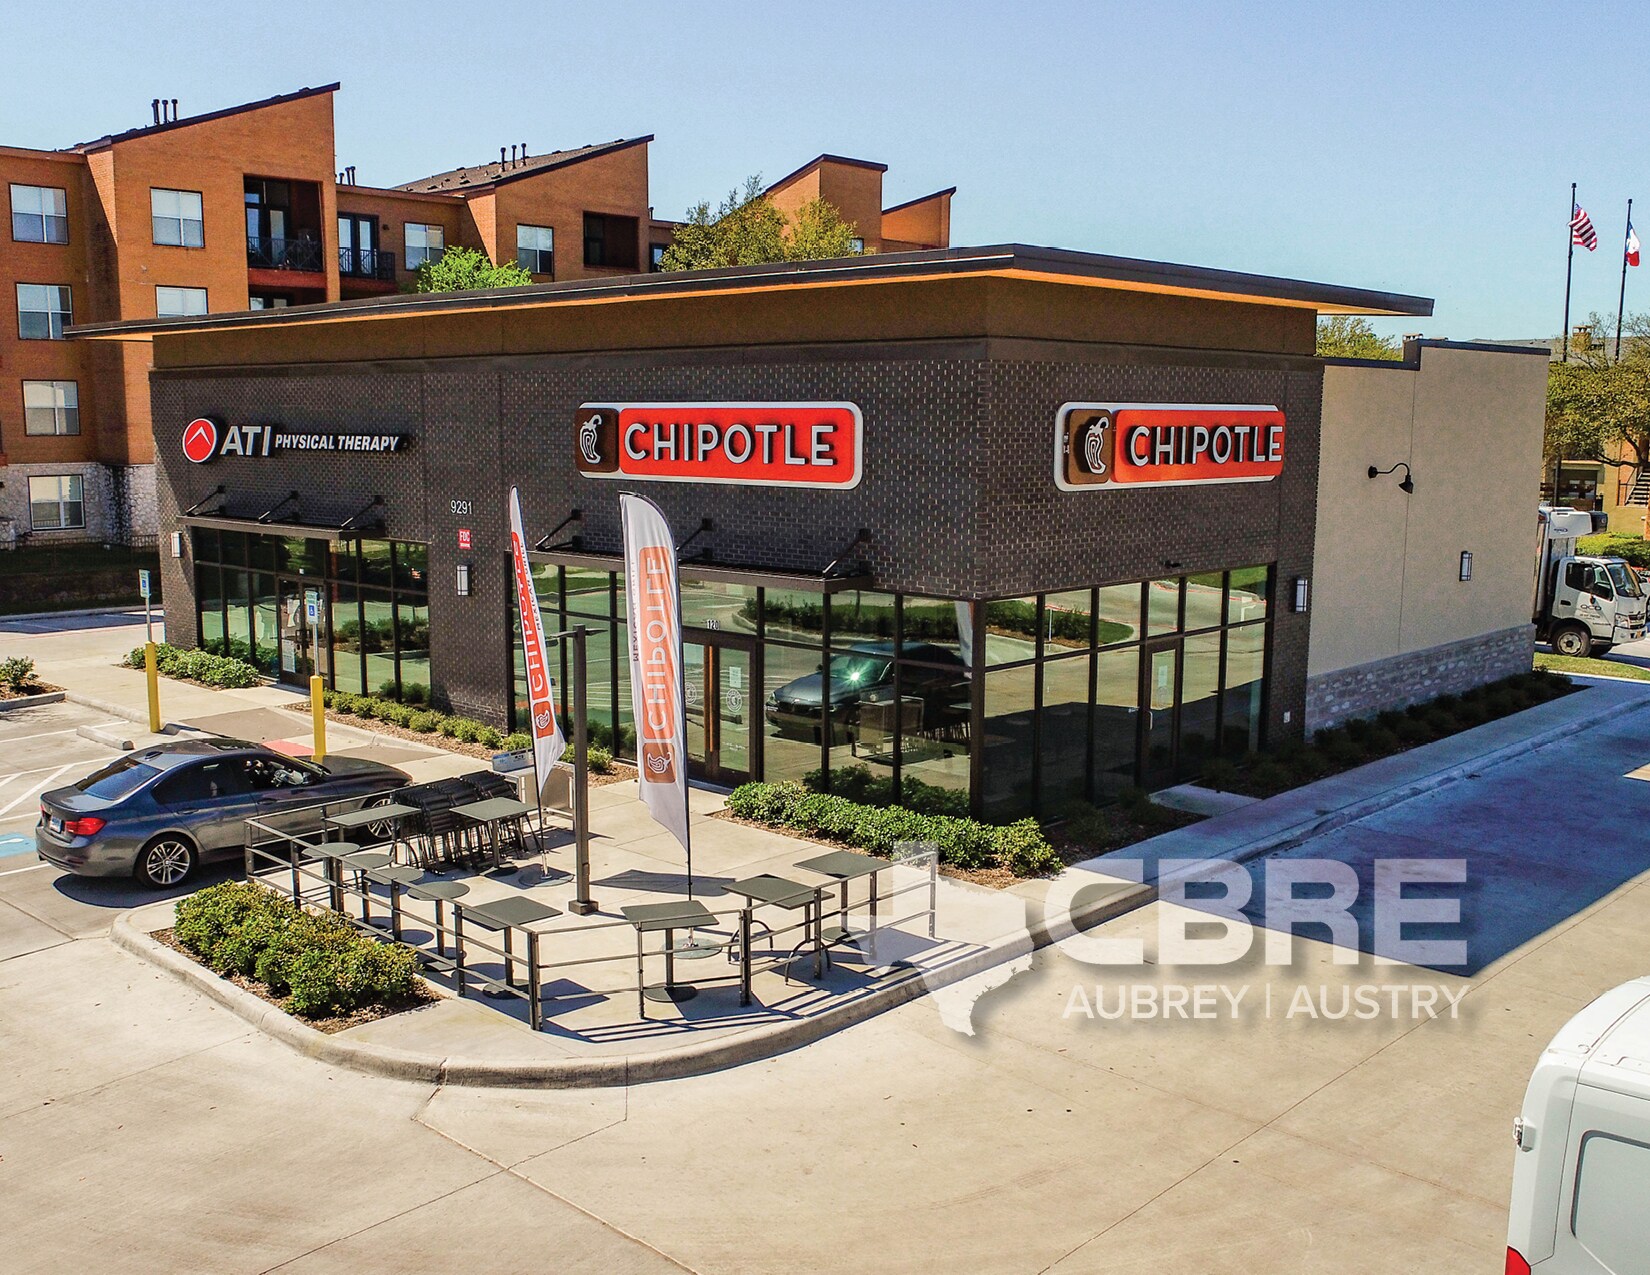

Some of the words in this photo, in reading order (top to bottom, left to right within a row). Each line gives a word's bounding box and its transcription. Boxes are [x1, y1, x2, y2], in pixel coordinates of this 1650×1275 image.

[220, 425, 272, 456] ATI
[275, 433, 335, 450] PHYSICAL
[337, 435, 399, 451] THERAPY
[624, 423, 835, 466] CHIPOTLE
[1130, 426, 1283, 466] CHIPOTLE
[450, 499, 473, 515] 9291
[459, 531, 471, 542] FDC
[706, 619, 720, 630] 120
